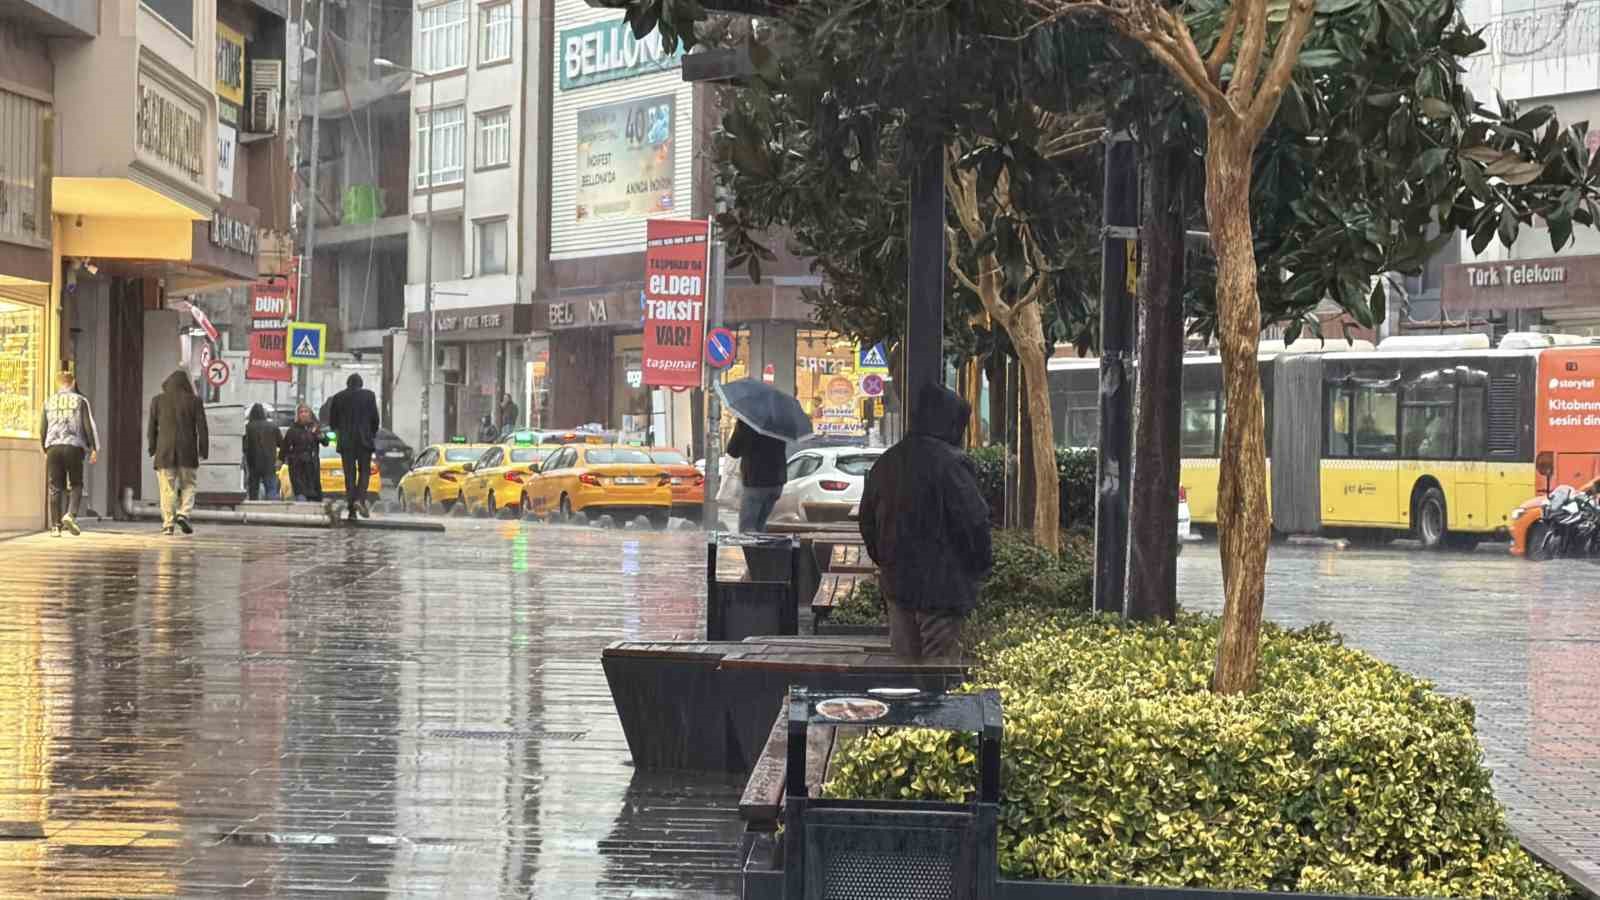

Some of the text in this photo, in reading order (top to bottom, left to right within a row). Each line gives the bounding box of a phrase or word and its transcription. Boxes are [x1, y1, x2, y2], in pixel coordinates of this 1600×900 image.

[1467, 263, 1566, 287] Türk Telekom
[656, 325, 692, 346] VAR!
[1549, 413, 1581, 426] sesini
